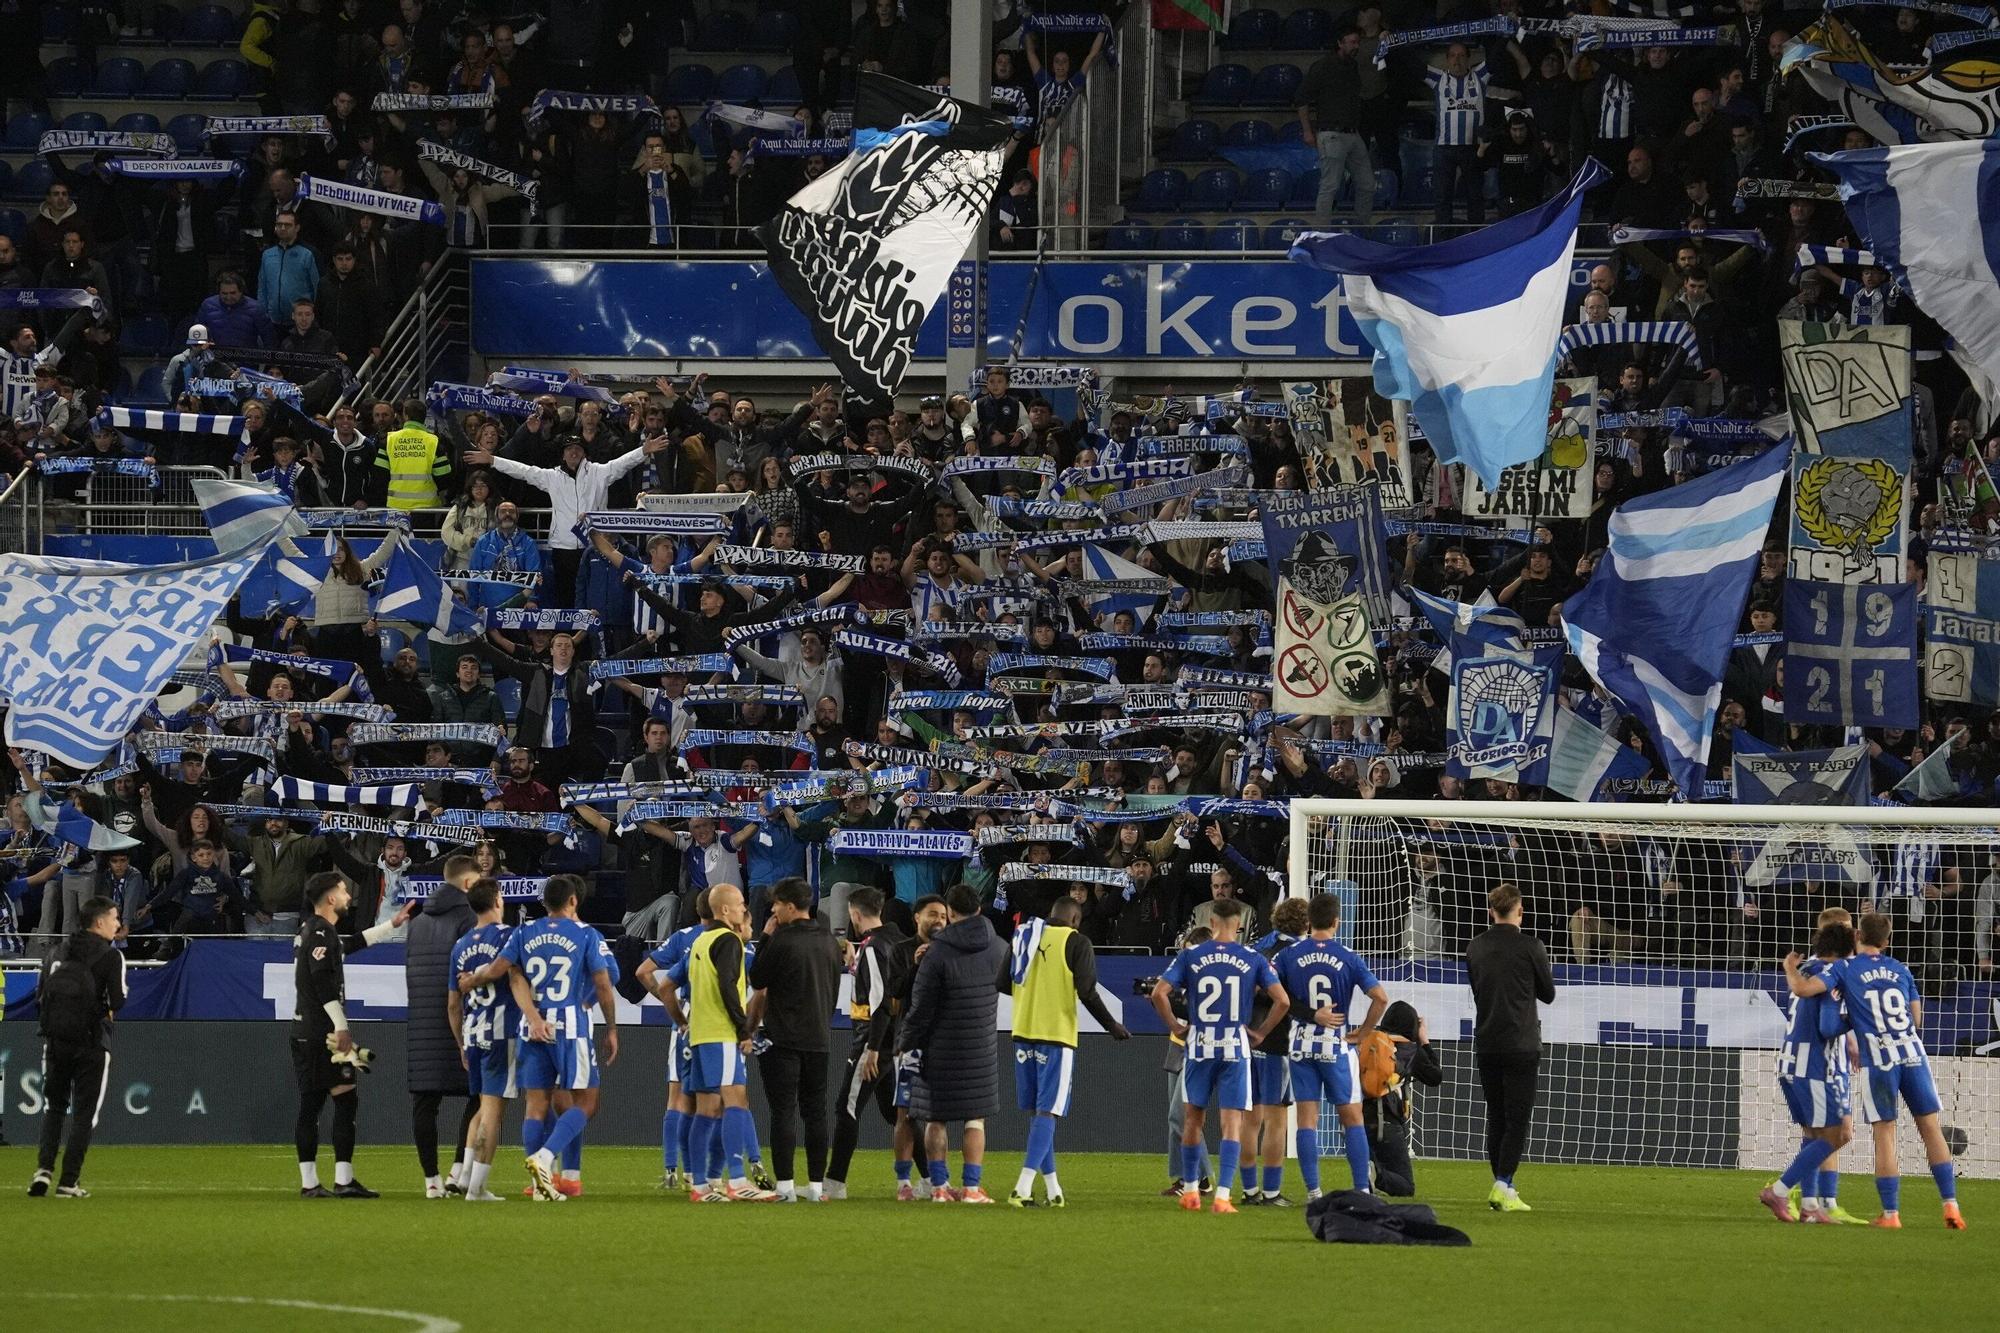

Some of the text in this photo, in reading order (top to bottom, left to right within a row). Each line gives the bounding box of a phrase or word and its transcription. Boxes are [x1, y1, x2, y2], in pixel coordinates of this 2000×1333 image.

[550, 97, 637, 112] ALAVES
[9, 373, 36, 384] betwa
[1160, 437, 1207, 454] ERREKO
[1356, 438, 1368, 451] 19
[1384, 430, 1395, 443] 21
[1476, 469, 1577, 493] SES MI
[1266, 497, 1304, 513] ZUEN
[1311, 486, 1373, 507] AMETSIK
[1478, 491, 1570, 517] JARDIN
[600, 516, 661, 528] DEPORTIVO
[1275, 502, 1365, 529] TXARRENA
[1938, 556, 1964, 603] 1
[1810, 591, 1894, 637] 1 9
[837, 628, 911, 659] AULTZA
[253, 648, 311, 662] DEPORTIVO
[1932, 648, 1965, 697] 2
[1001, 679, 1038, 691] SKAL
[1806, 665, 1885, 717] 2 1
[895, 695, 932, 711] urea
[864, 743, 963, 773] KOMANDO
[1465, 744, 1526, 763] GLORIOSO
[1751, 757, 1857, 773] PLAY HARD
[847, 831, 961, 851] DEPORTIVO ALAVÉS
[505, 879, 534, 897] AVÉS
[524, 933, 577, 955] PROTESONI
[1190, 952, 1251, 974] A.REBBACH
[1297, 952, 1345, 972] GUEVARA
[525, 955, 573, 1002] 23
[1198, 975, 1241, 1023] 21
[1308, 974, 1333, 1010] 6
[1864, 988, 1910, 1033] 19
